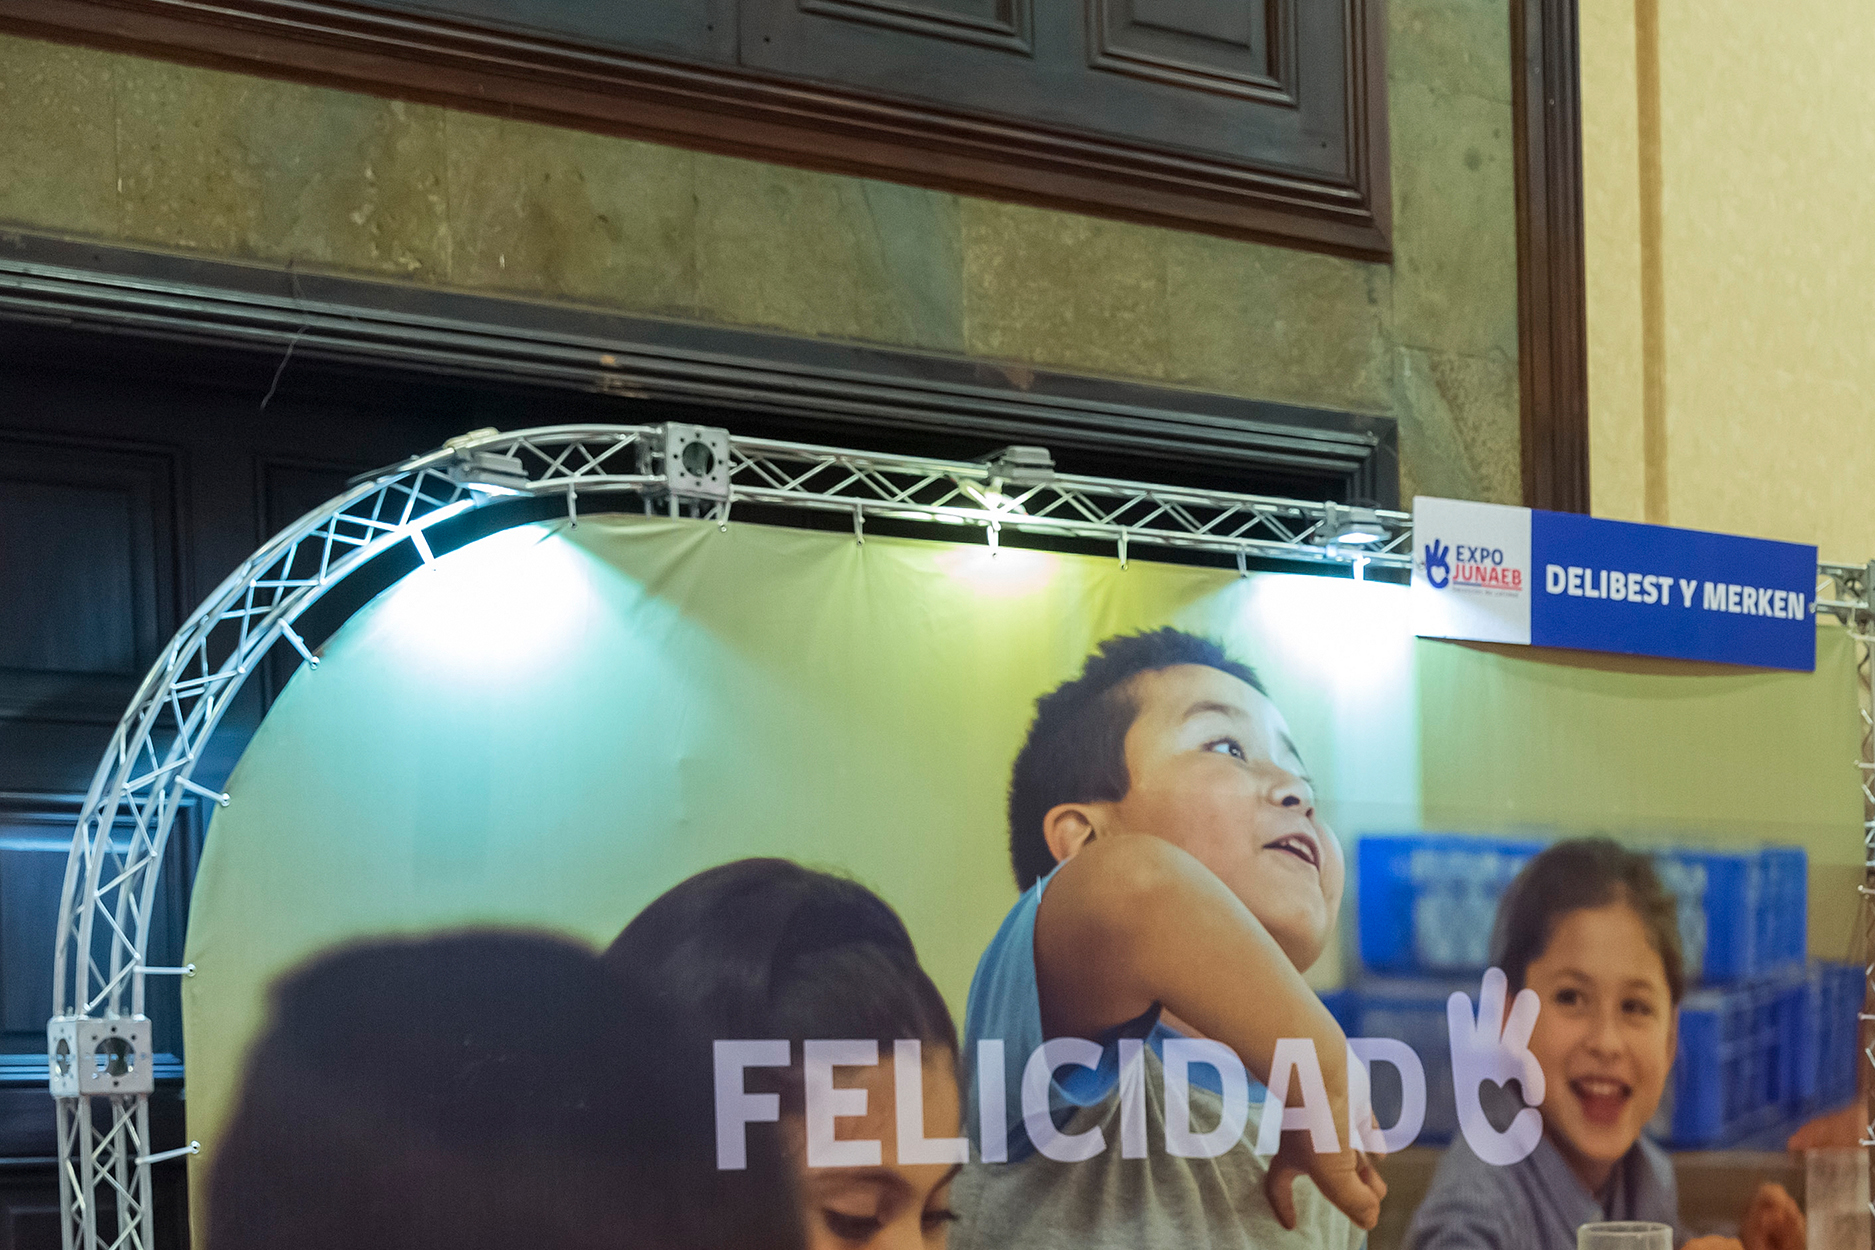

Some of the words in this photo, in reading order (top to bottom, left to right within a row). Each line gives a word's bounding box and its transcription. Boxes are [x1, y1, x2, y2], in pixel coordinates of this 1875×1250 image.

[1452, 563, 1522, 586] JUNAEB
[1456, 545, 1504, 566] EXPO
[1545, 563, 1674, 606] DELIBEST
[1678, 578, 1698, 608] Y
[1703, 581, 1806, 621] MERKEN
[712, 1036, 1428, 1171] FELICIDAD
